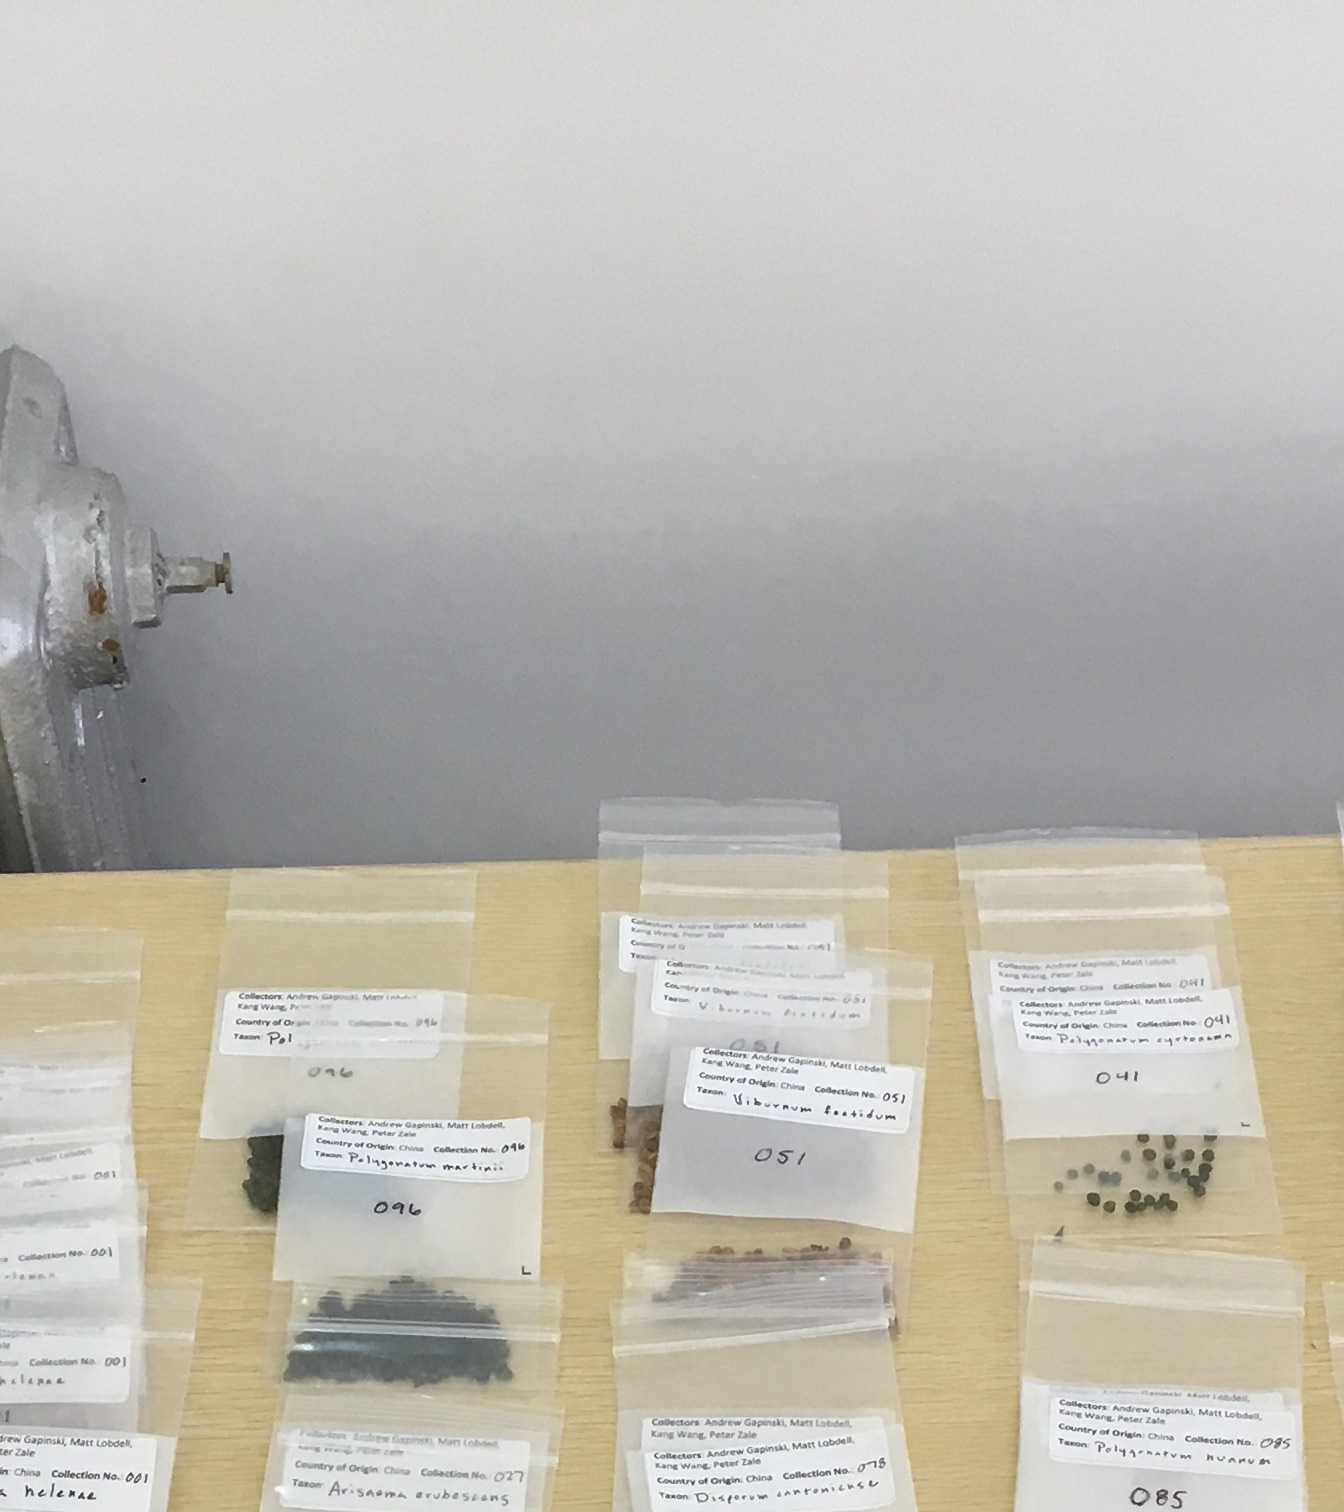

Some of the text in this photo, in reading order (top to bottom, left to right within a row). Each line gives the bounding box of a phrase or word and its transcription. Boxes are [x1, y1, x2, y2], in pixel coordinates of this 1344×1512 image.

[307, 1066, 354, 1078] 096
[1096, 1071, 1139, 1084] 041
[882, 1091, 906, 1104] 051
[754, 1147, 806, 1165] 051
[373, 1201, 422, 1217] 096
[24, 1436, 66, 1447] Gapinski,
[70, 1438, 94, 1447] Matt
[96, 1438, 133, 1449] Lobdell,
[1259, 1436, 1292, 1450] 085
[16, 1448, 36, 1457] Zale
[857, 1457, 887, 1473] 078
[13, 1468, 41, 1477] China
[51, 1470, 101, 1480] Collection
[125, 1471, 148, 1484] 001
[1129, 1487, 1188, 1509] 085
